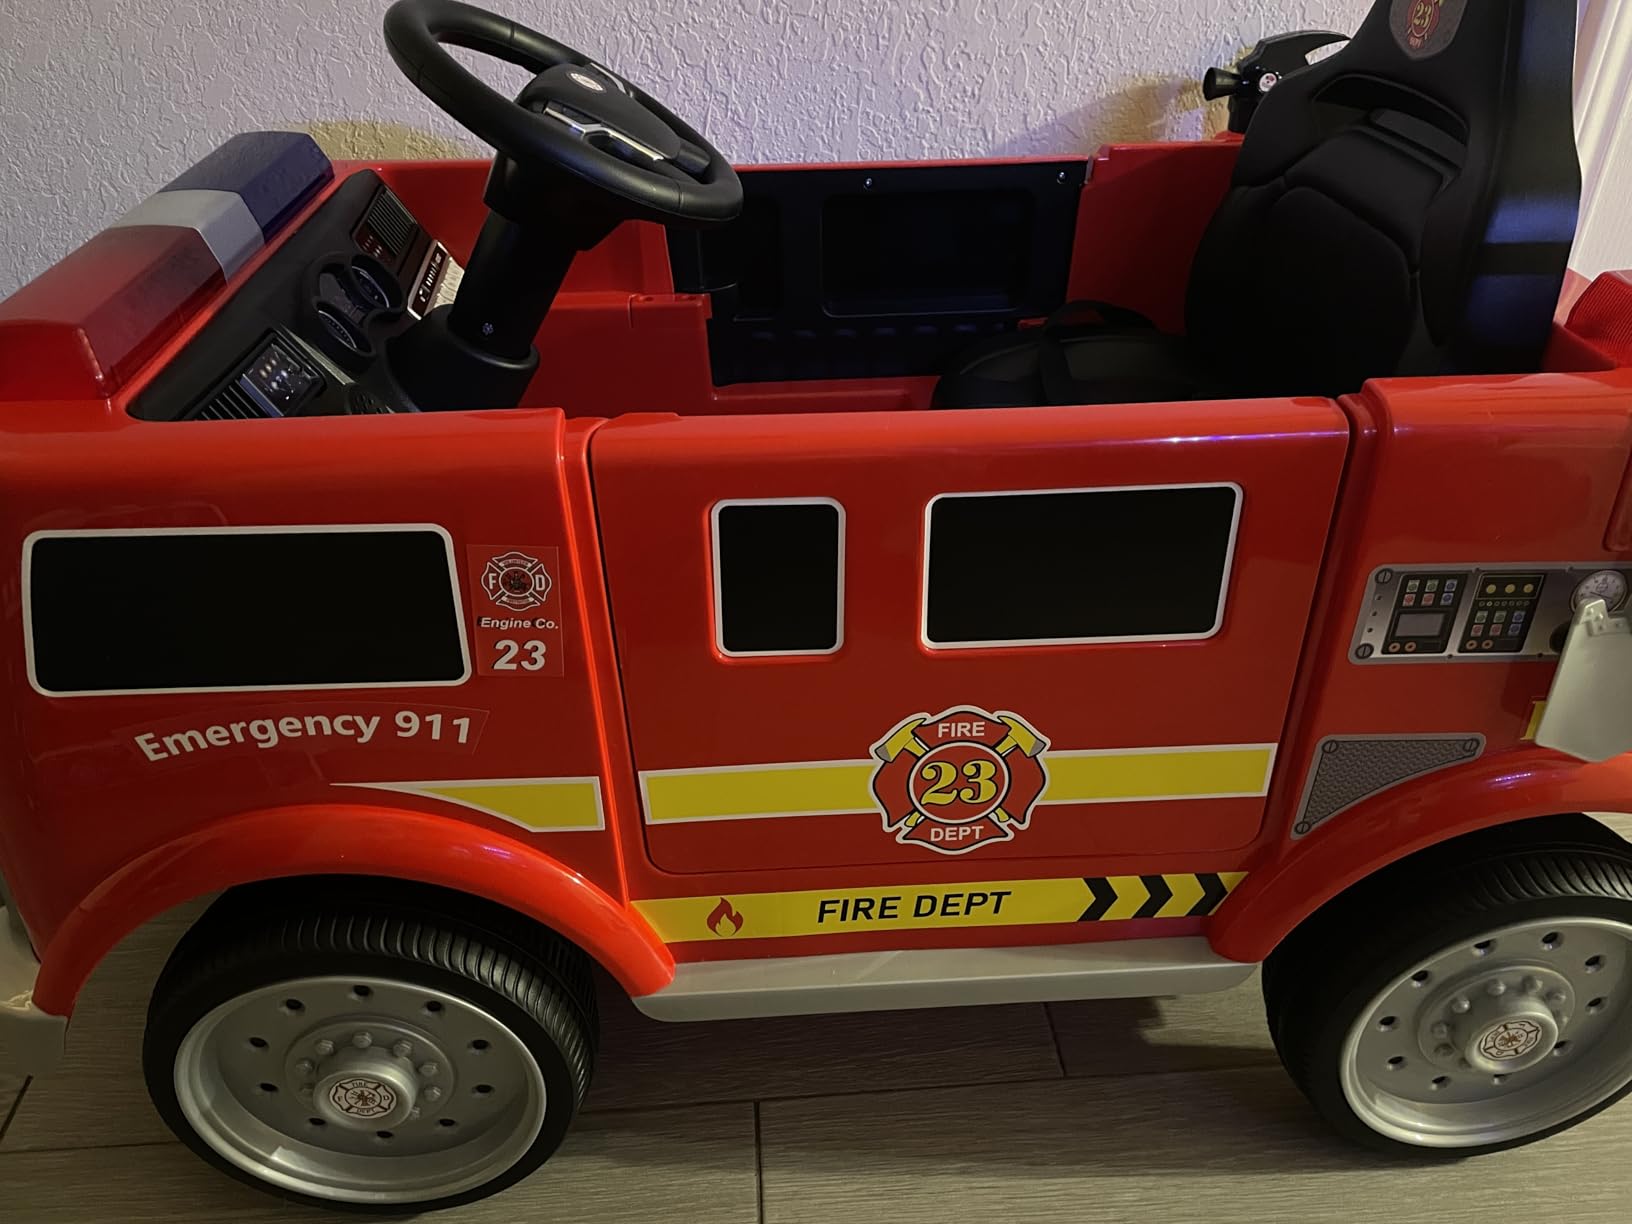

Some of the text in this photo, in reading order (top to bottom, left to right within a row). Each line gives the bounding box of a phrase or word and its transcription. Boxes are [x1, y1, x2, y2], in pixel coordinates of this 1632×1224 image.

[1413, 2, 1431, 28] 23
[488, 573, 497, 589] F
[535, 574, 545, 591] D
[480, 617, 559, 630] Engine Co.
[493, 639, 547, 671] 23
[134, 710, 470, 761] Emergency 911
[937, 721, 985, 738] FIRE
[920, 759, 998, 806] 23
[930, 825, 984, 842] DEPT
[817, 891, 1012, 923] FIRE DEPT
